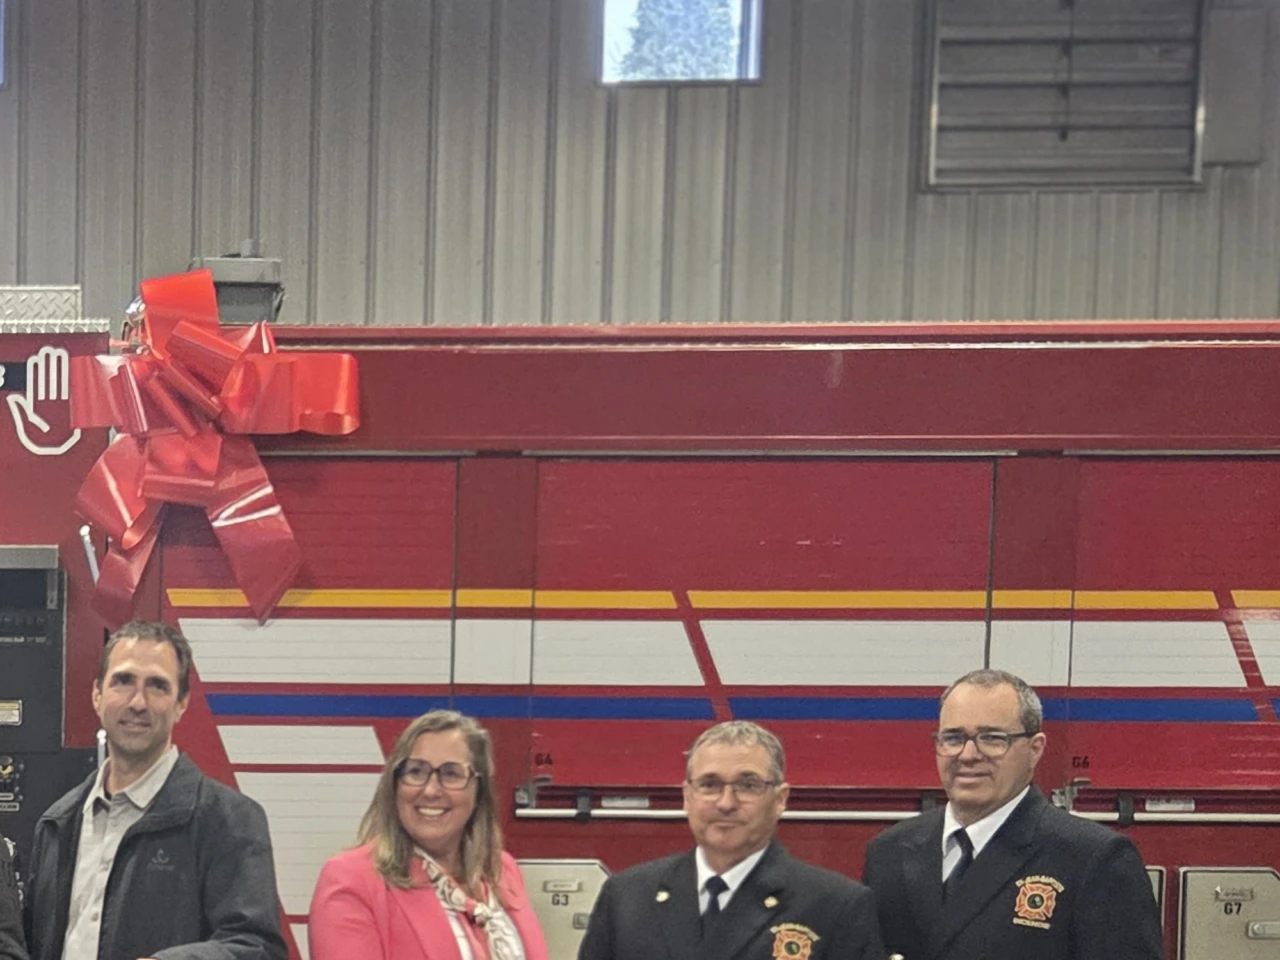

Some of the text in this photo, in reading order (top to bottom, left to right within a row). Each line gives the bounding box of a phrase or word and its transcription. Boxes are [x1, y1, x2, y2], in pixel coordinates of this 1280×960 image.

[1072, 756, 1090, 769] G6
[551, 893, 570, 907] G3
[1223, 902, 1242, 916] G7
